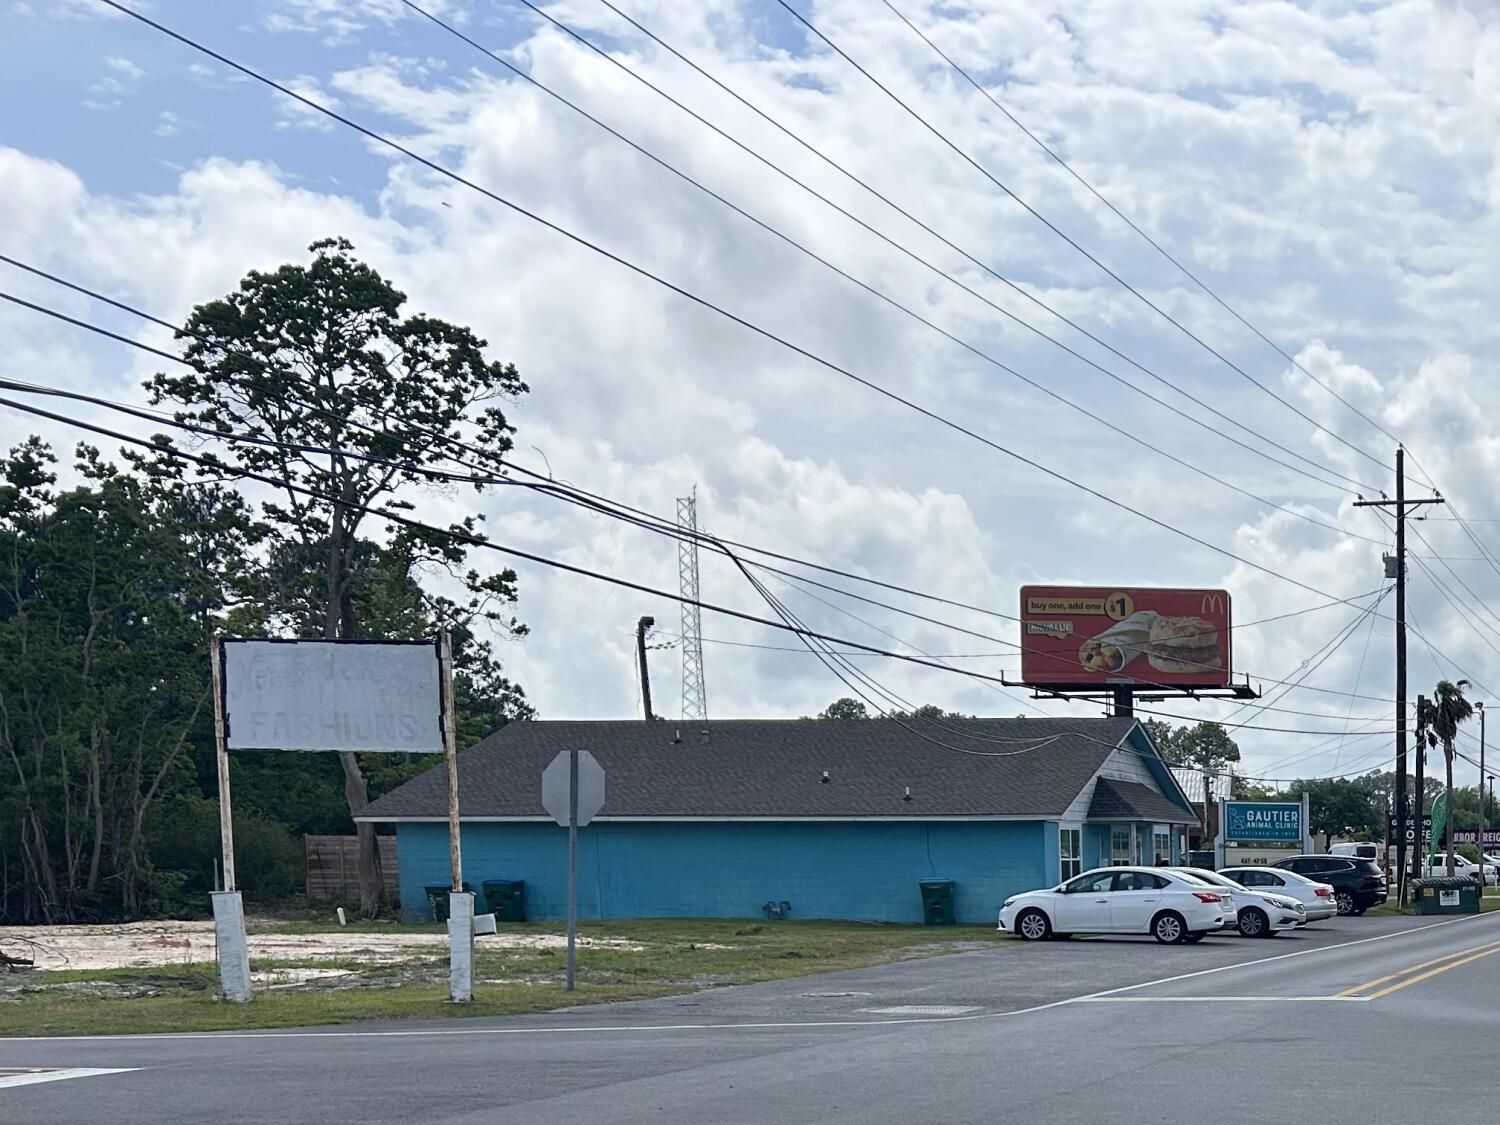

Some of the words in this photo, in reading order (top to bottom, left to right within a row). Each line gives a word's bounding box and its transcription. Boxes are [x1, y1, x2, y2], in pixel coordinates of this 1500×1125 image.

[1031, 601, 1047, 611] buy
[1048, 602, 1066, 611] one,
[1067, 602, 1084, 610] add
[1109, 597, 1126, 617] $1
[1246, 810, 1298, 822] GAUTIER
[1246, 821, 1272, 829] ANIMAL
